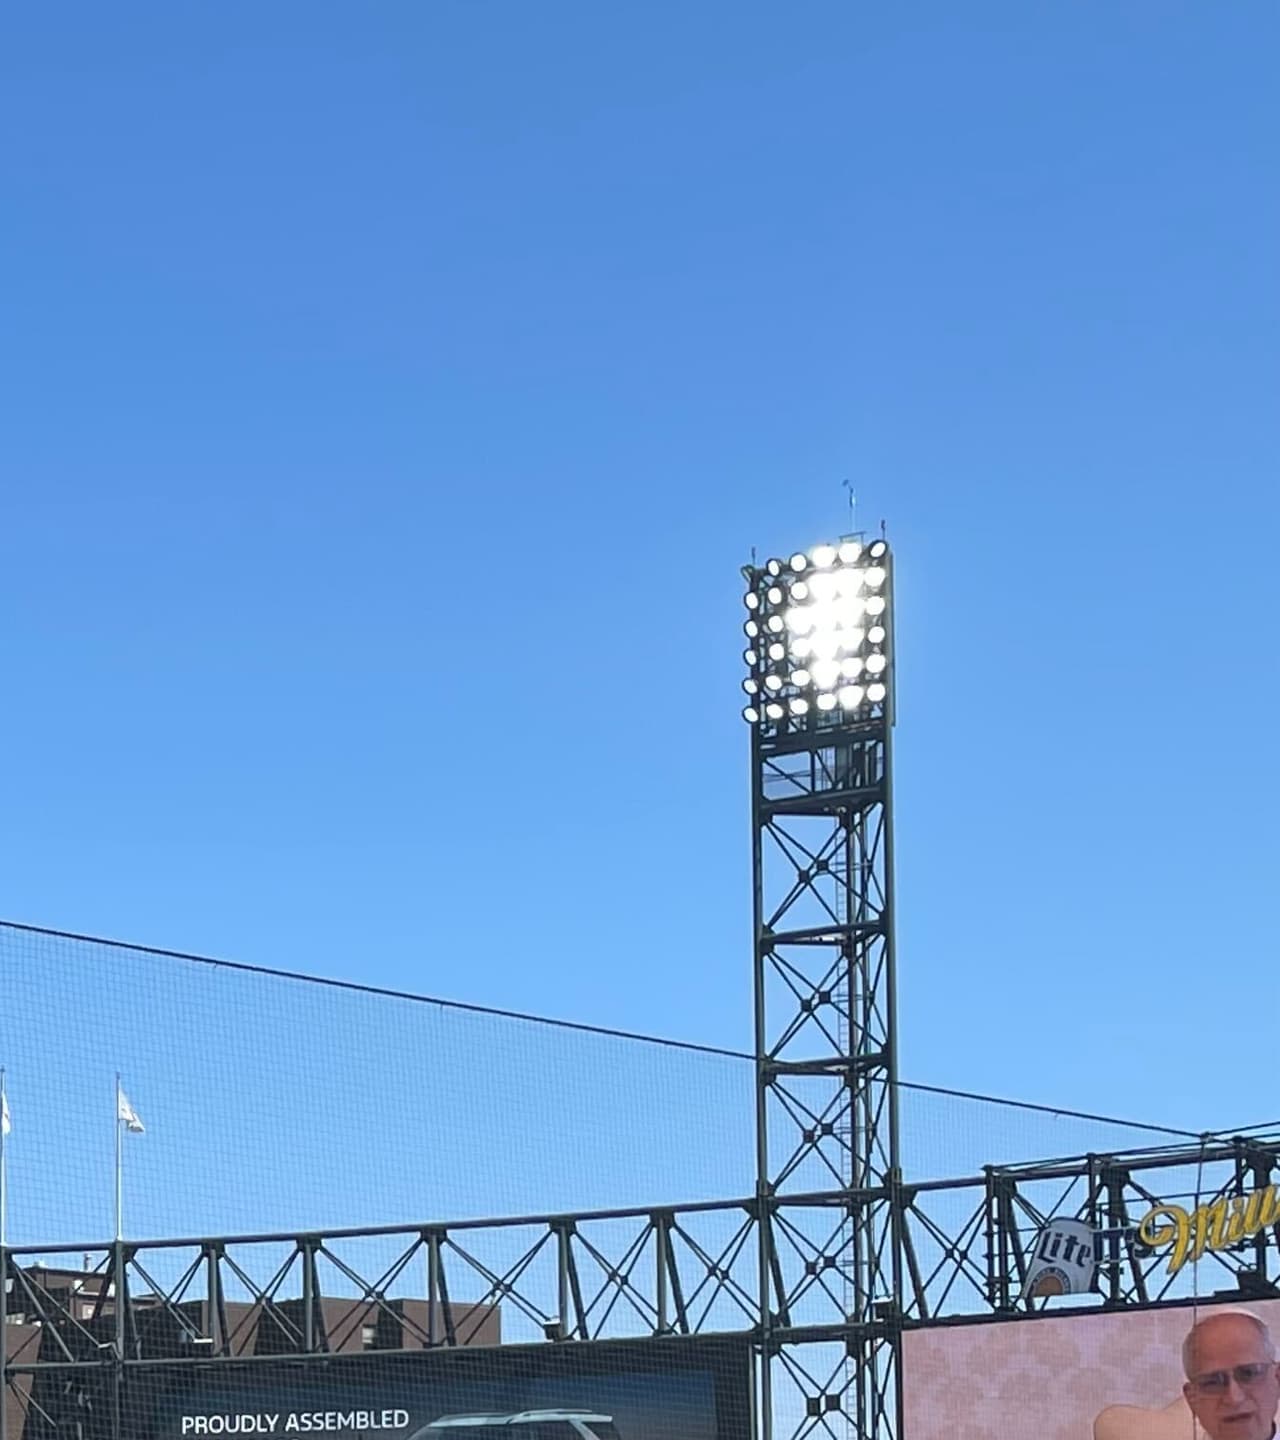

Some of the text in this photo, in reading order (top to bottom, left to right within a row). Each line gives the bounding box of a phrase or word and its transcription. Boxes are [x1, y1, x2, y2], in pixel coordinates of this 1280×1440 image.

[1140, 1184, 1280, 1275] Mill
[1036, 1230, 1092, 1268] Lite
[181, 1409, 409, 1435] PROUDLY ASSEMBLED
